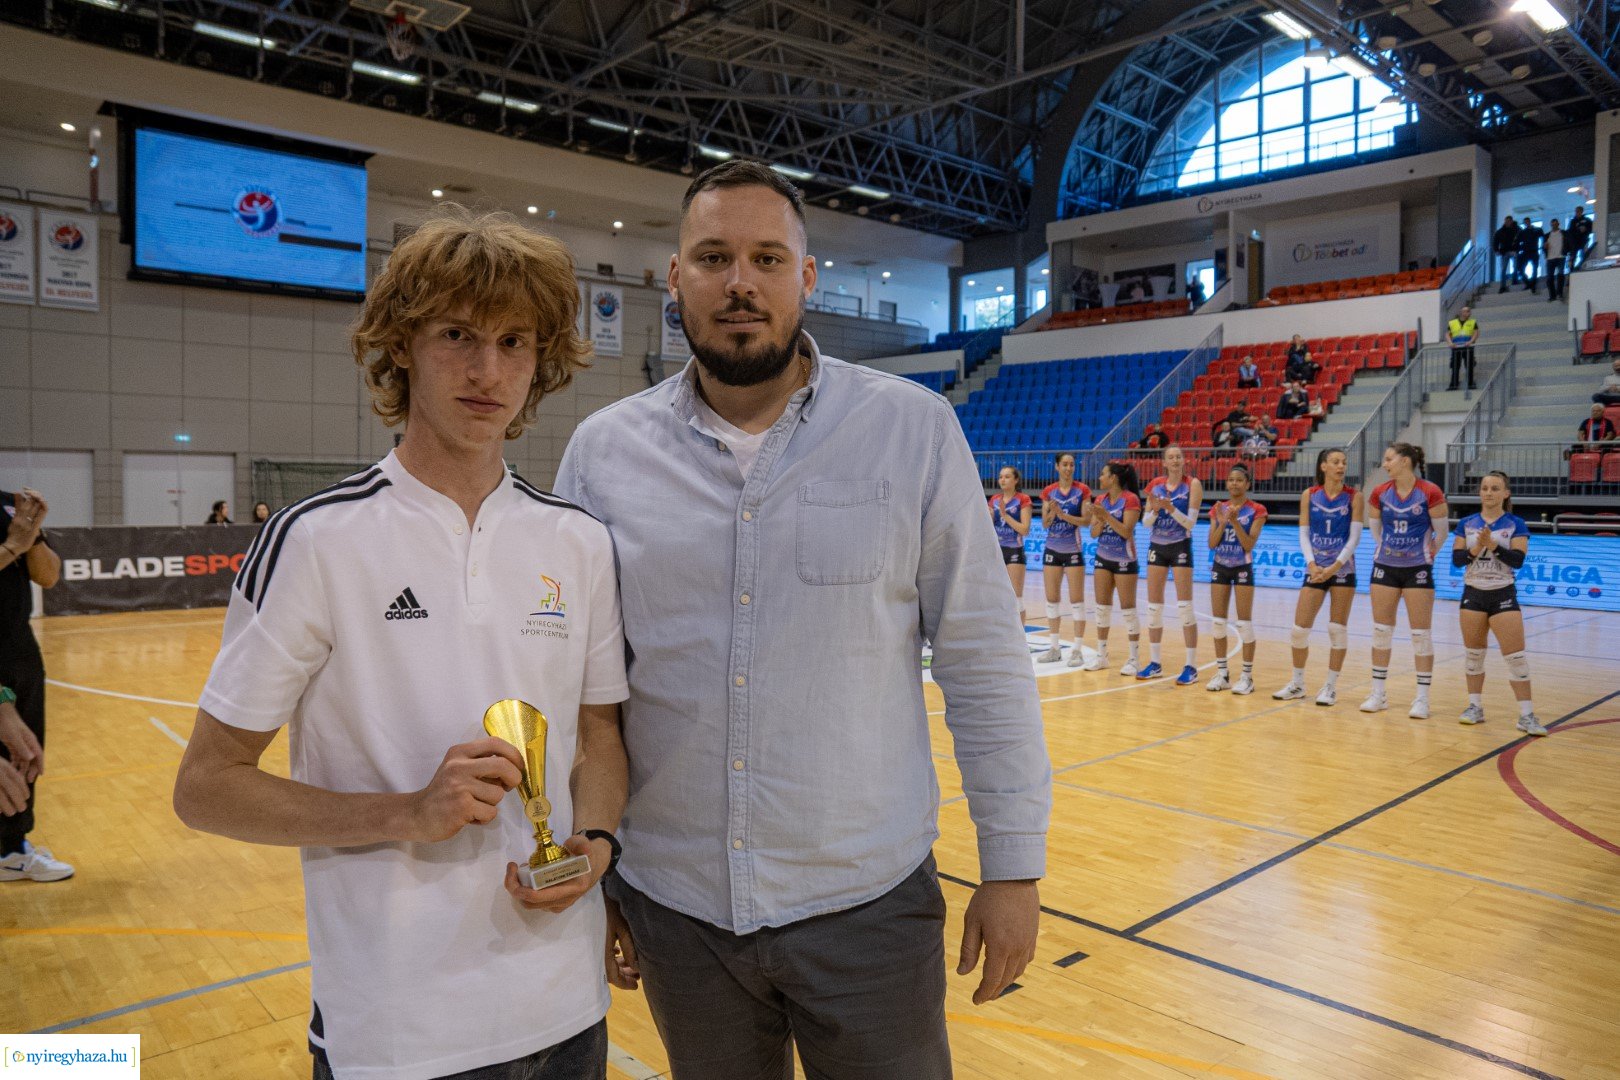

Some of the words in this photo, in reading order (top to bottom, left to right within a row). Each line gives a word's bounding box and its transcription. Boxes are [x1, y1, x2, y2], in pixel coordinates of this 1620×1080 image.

[1325, 519, 1332, 534] 1
[1224, 528, 1236, 542] 12
[384, 607, 429, 621] adidas
[520, 628, 569, 640] SPORTCENTRUM
